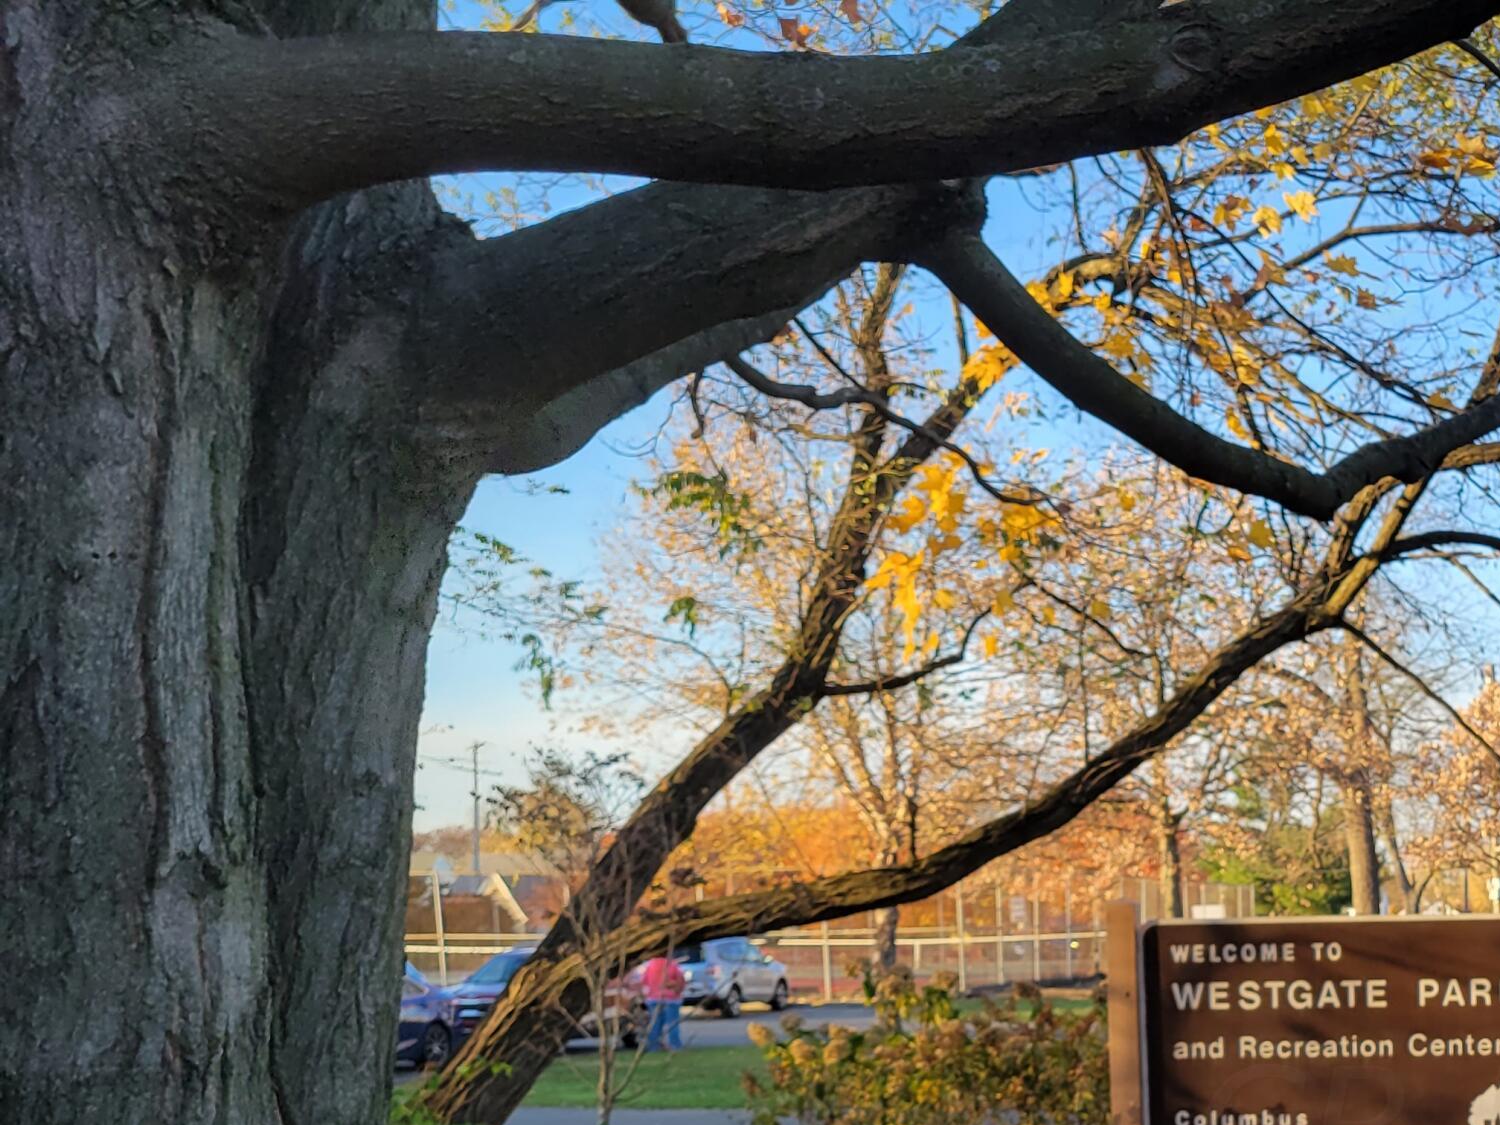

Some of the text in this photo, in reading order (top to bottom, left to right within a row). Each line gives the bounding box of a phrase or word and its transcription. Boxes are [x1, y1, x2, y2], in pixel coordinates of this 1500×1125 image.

[1169, 941, 1343, 964] WELCOME TO
[1171, 978, 1389, 1011] WESTGATE
[1173, 1035, 1226, 1060] and
[1238, 1034, 1395, 1060] Recreation
